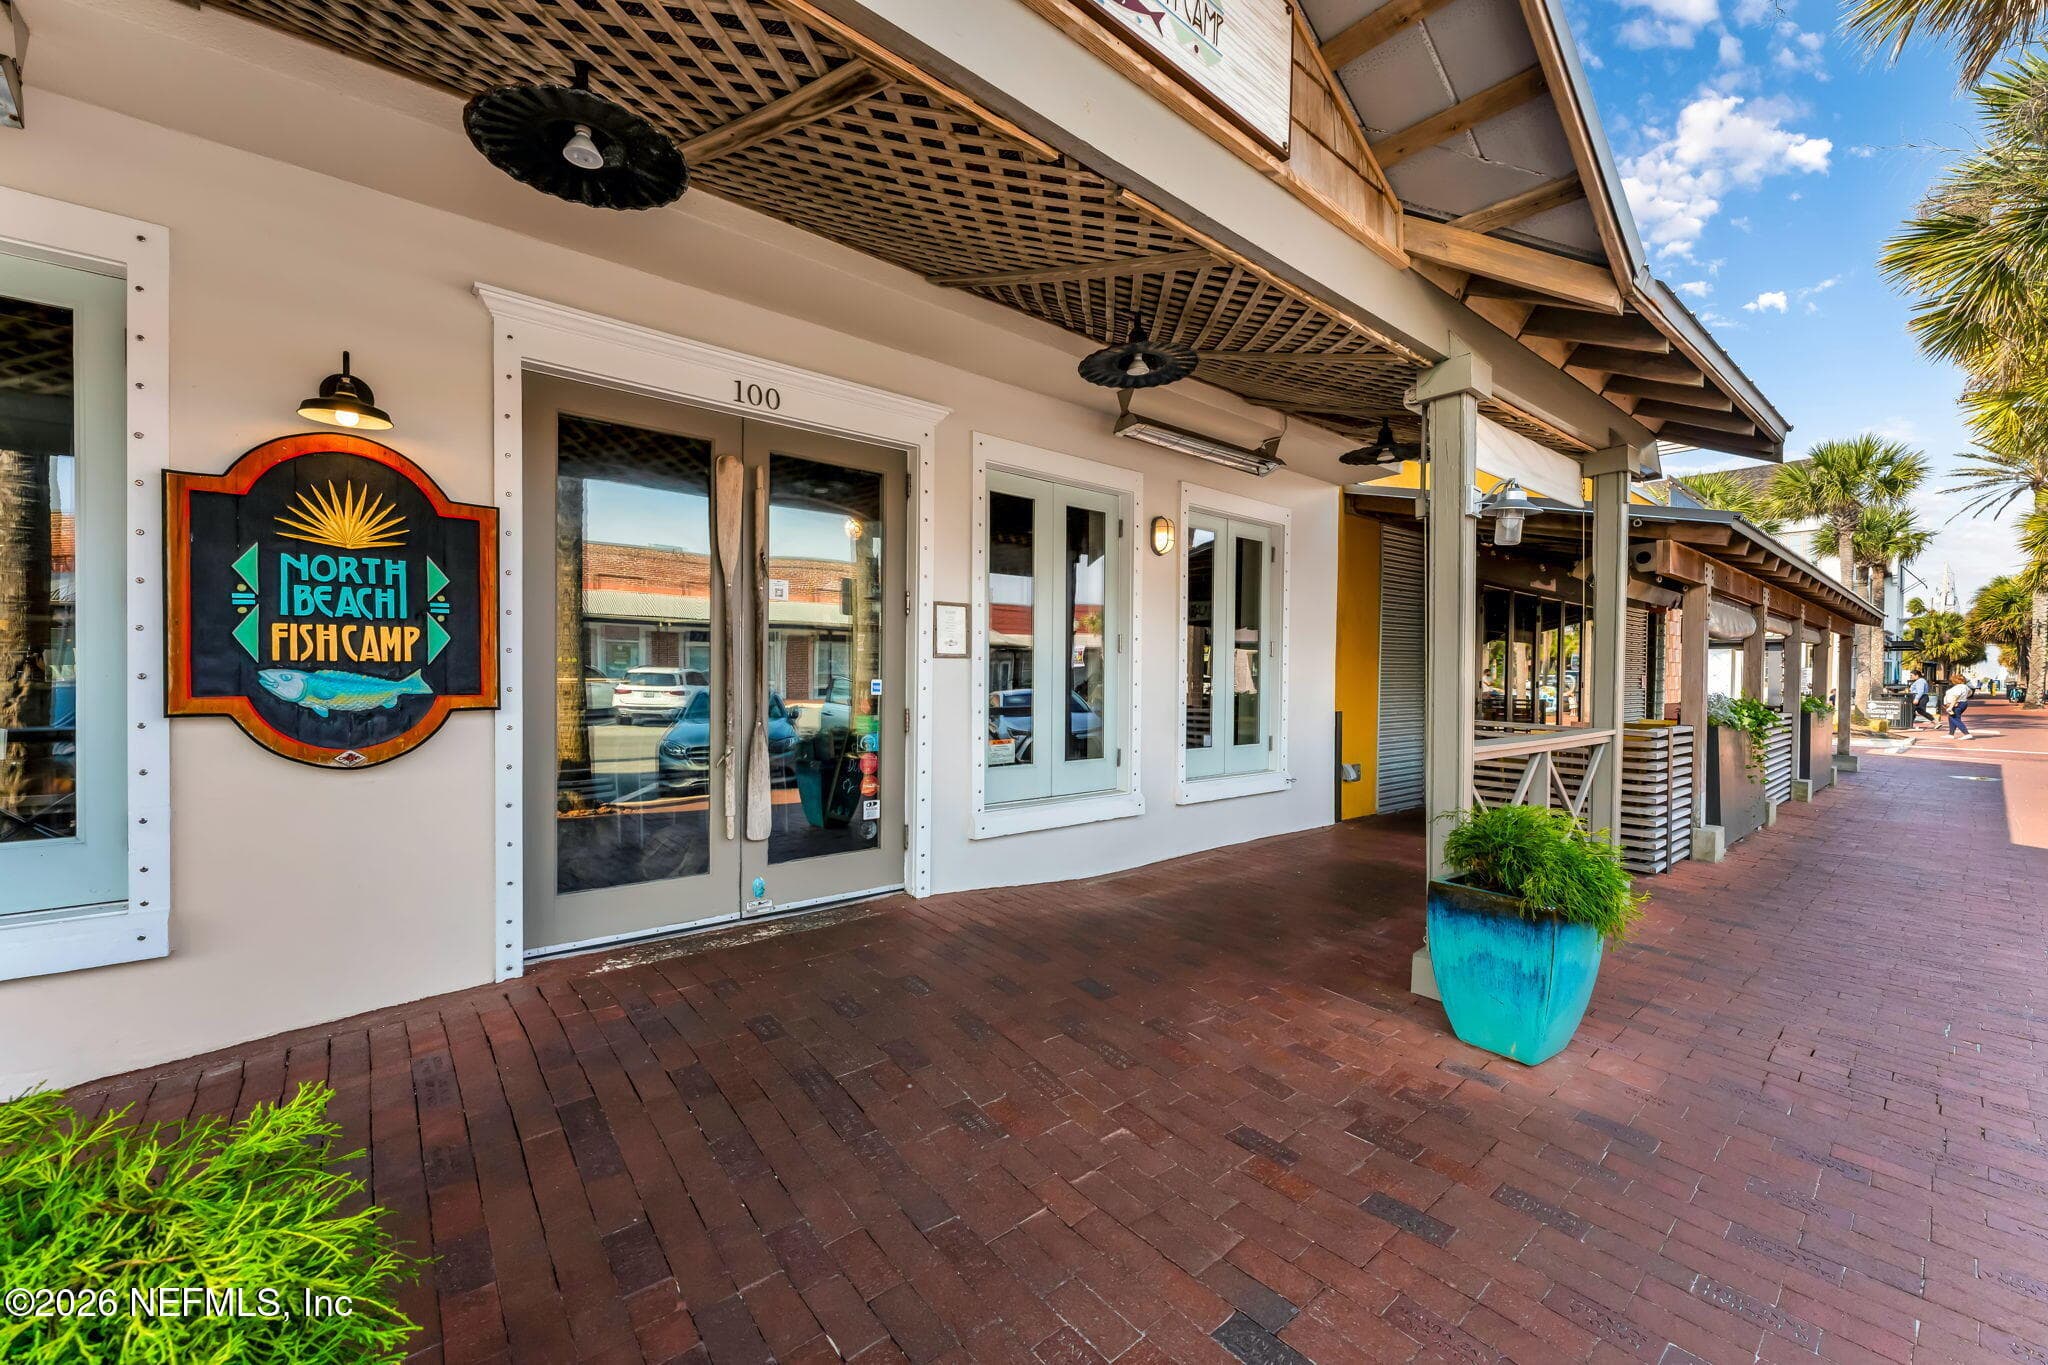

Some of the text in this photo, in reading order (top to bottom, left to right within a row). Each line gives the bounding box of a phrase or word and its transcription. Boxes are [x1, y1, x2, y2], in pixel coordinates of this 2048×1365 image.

[733, 380, 781, 410] 100
[280, 552, 408, 619] NORTH
[293, 584, 395, 620] BEACH
